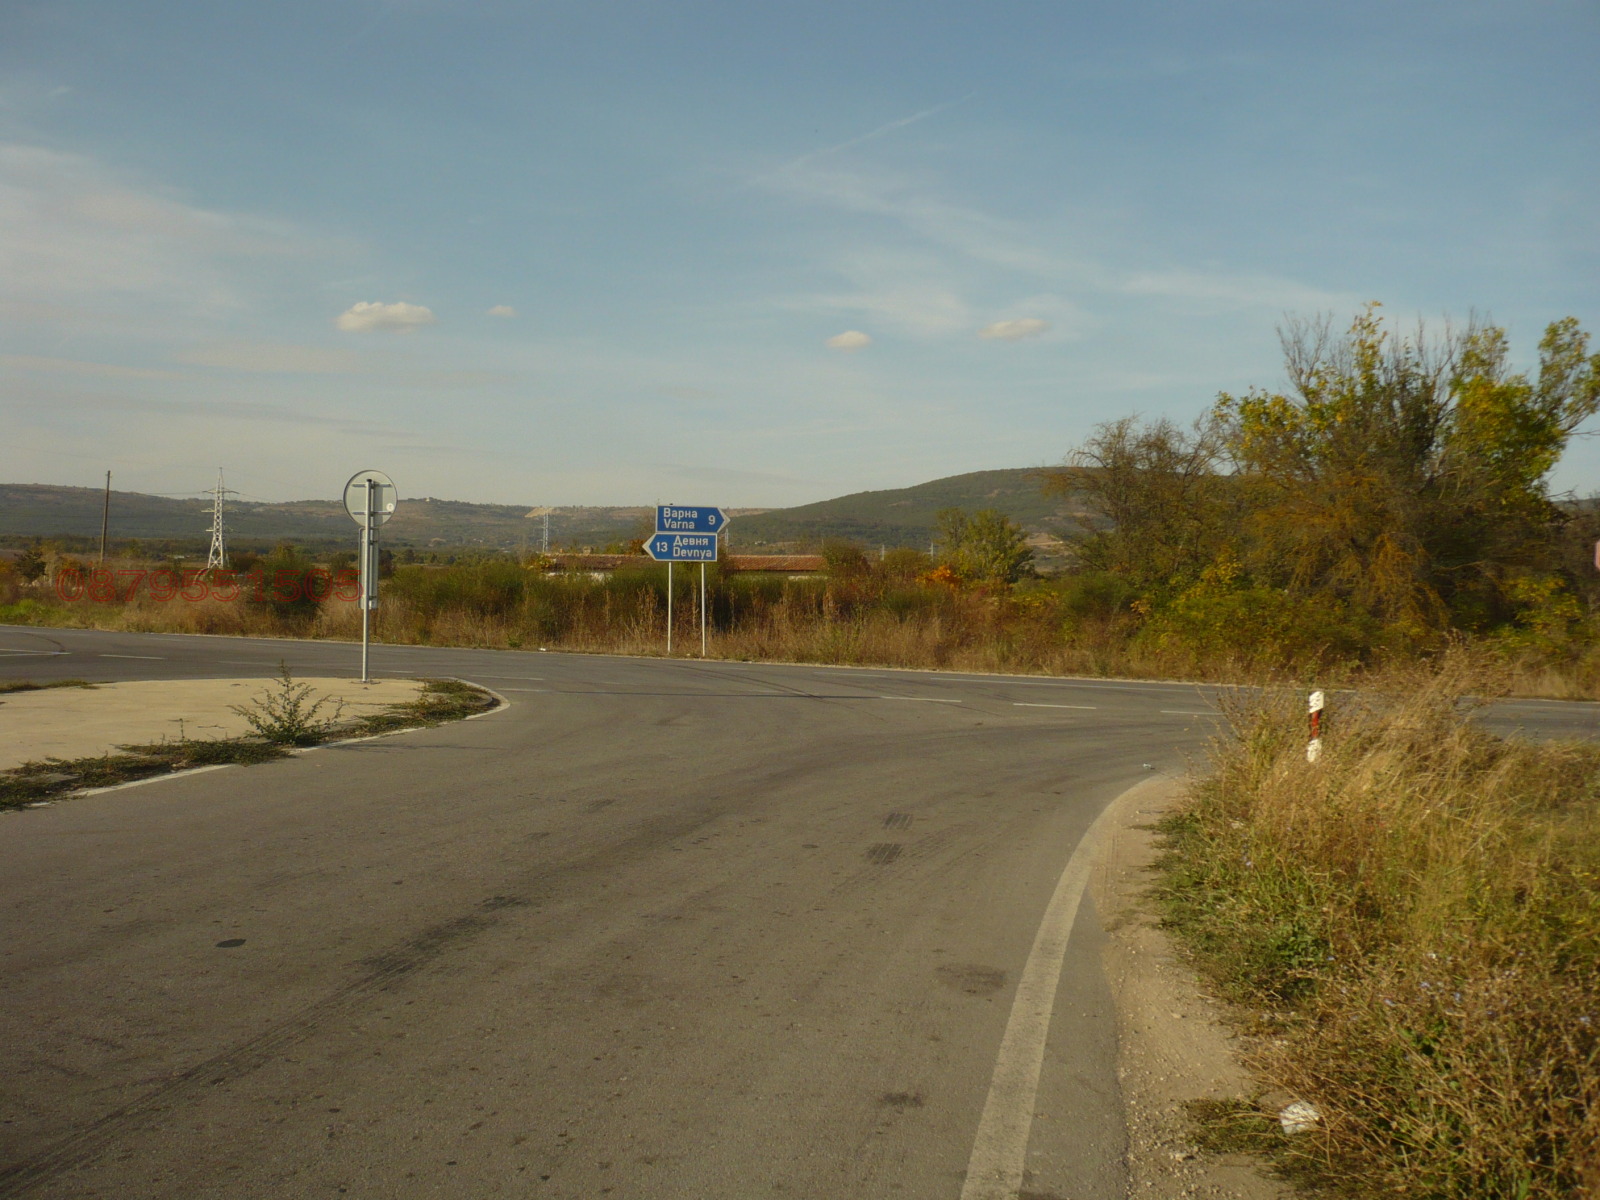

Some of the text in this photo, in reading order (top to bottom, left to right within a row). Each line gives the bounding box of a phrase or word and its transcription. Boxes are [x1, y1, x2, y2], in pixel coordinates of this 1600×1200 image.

[663, 507, 697, 520] Варна
[663, 518, 695, 529] Varna
[708, 515, 715, 525] 9
[673, 535, 708, 546] Девня
[656, 542, 668, 552] 13
[673, 547, 712, 559] Devnya
